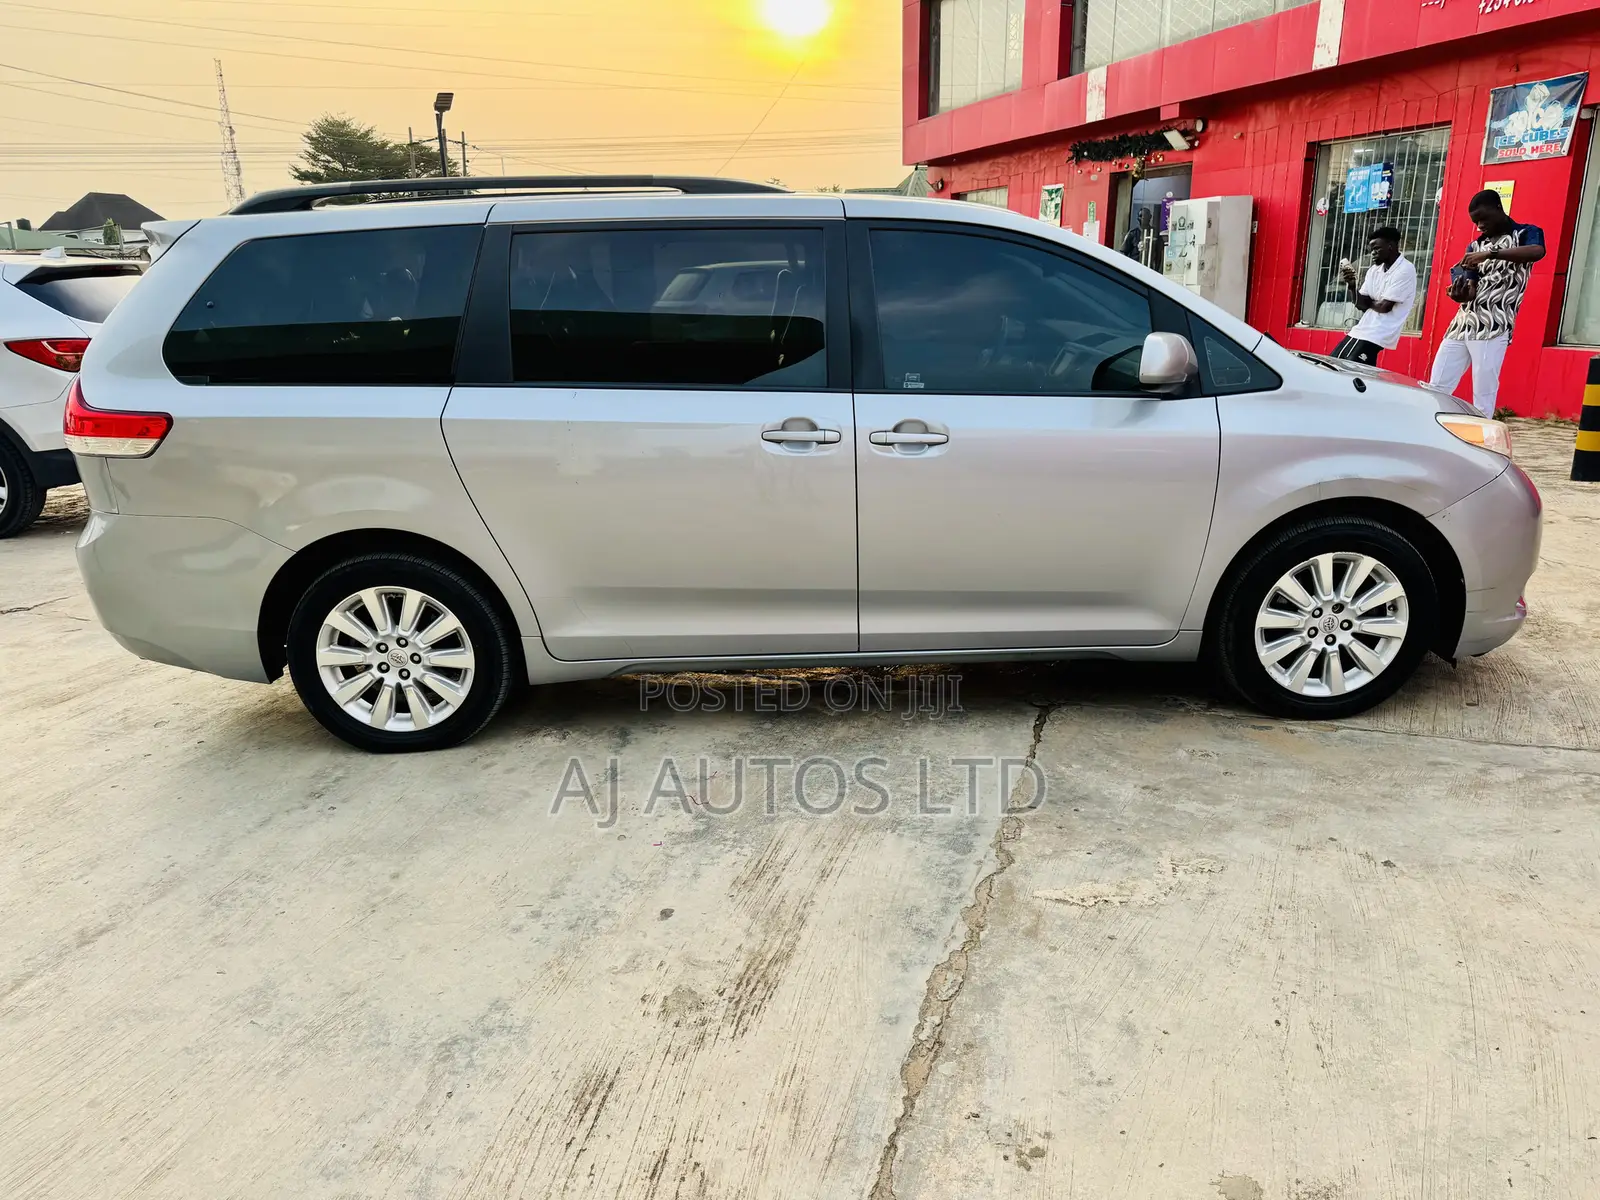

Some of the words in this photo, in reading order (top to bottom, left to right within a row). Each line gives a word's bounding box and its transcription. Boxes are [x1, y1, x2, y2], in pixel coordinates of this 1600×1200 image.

[1495, 136, 1516, 147] ICE
[1521, 128, 1569, 143] CUBES
[1498, 148, 1526, 157] SOLD
[1530, 144, 1561, 154] HERE
